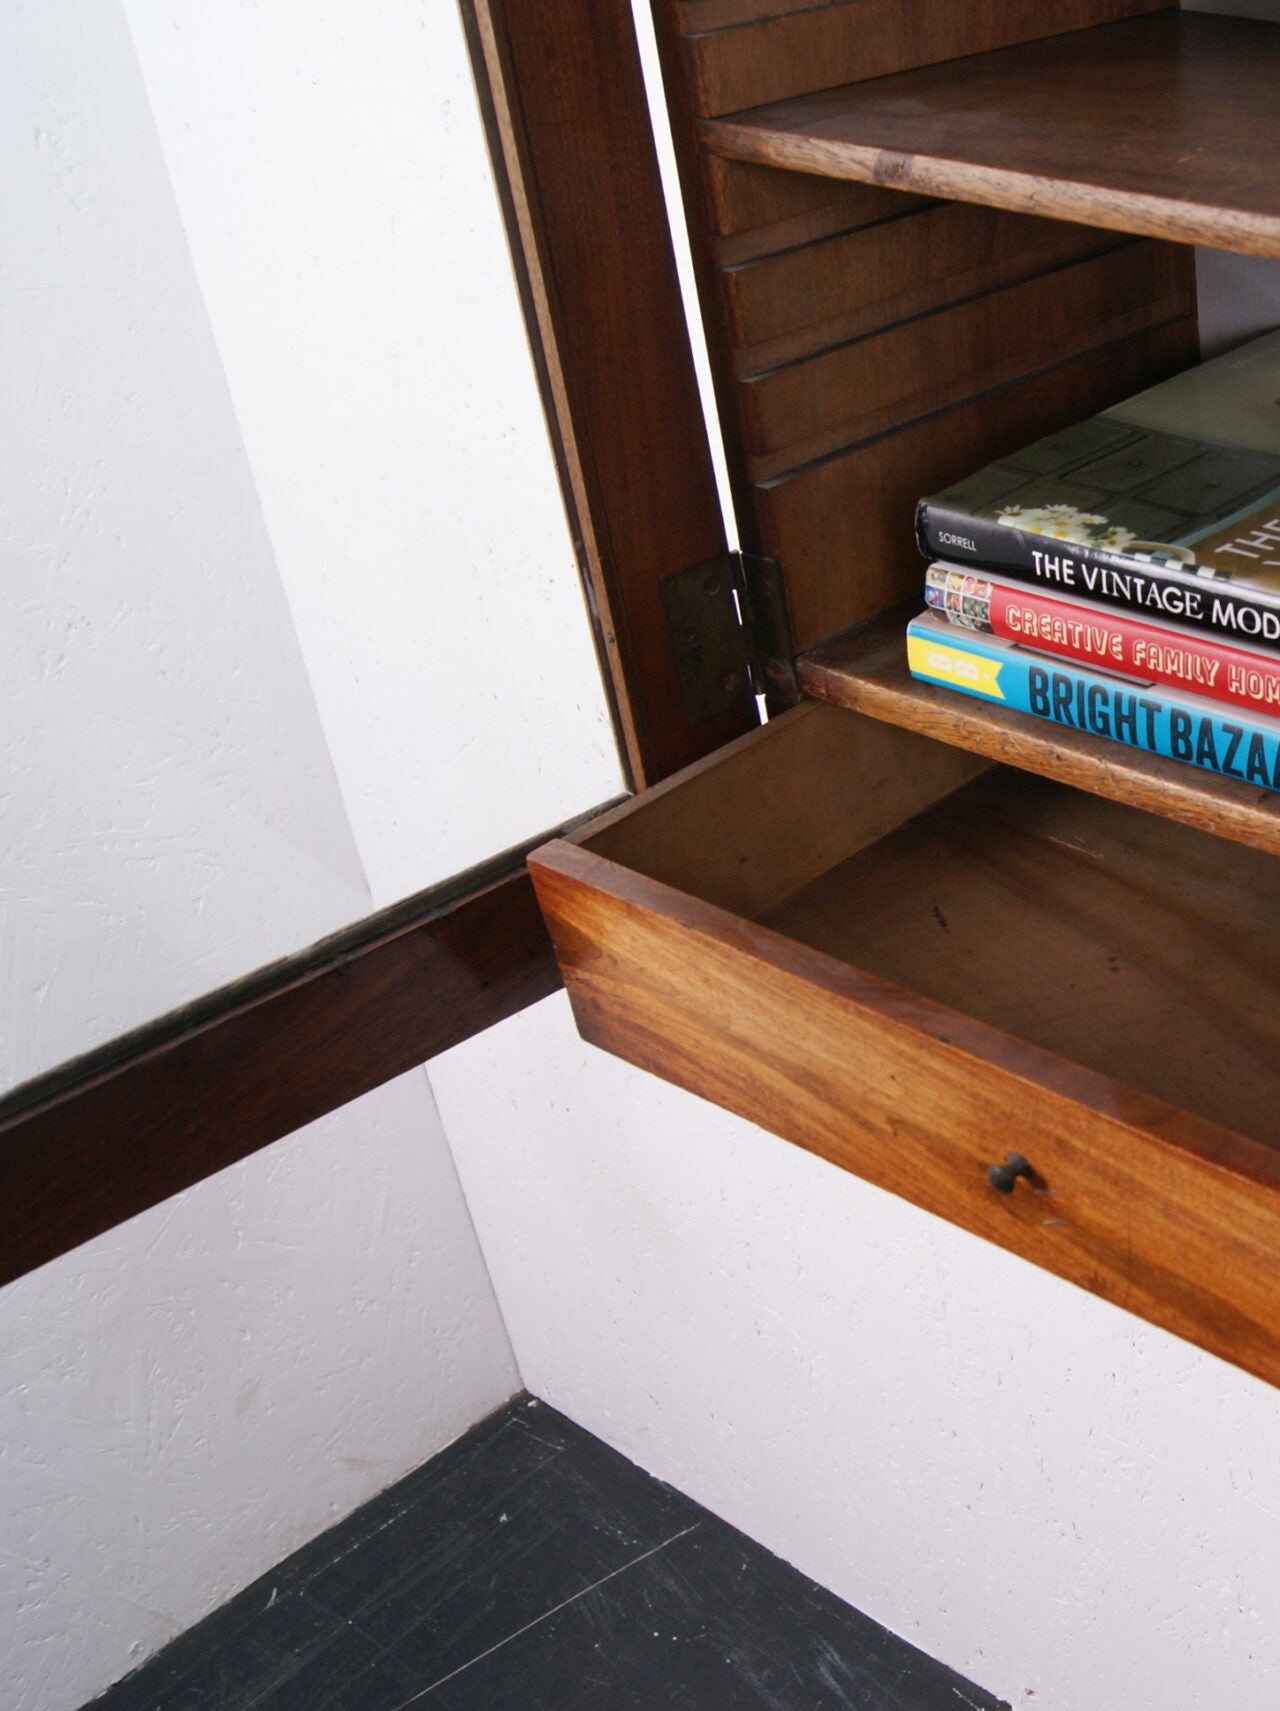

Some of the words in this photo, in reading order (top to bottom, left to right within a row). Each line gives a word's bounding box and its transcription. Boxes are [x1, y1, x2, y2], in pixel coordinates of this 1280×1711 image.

[938, 530, 978, 552] SORRELL
[1032, 550, 1076, 586] THE
[1081, 563, 1205, 620] VINTAGE
[1005, 604, 1124, 661] CREATIVE
[1132, 639, 1220, 687] FAMILY
[1028, 664, 1162, 754] BRIGHT
